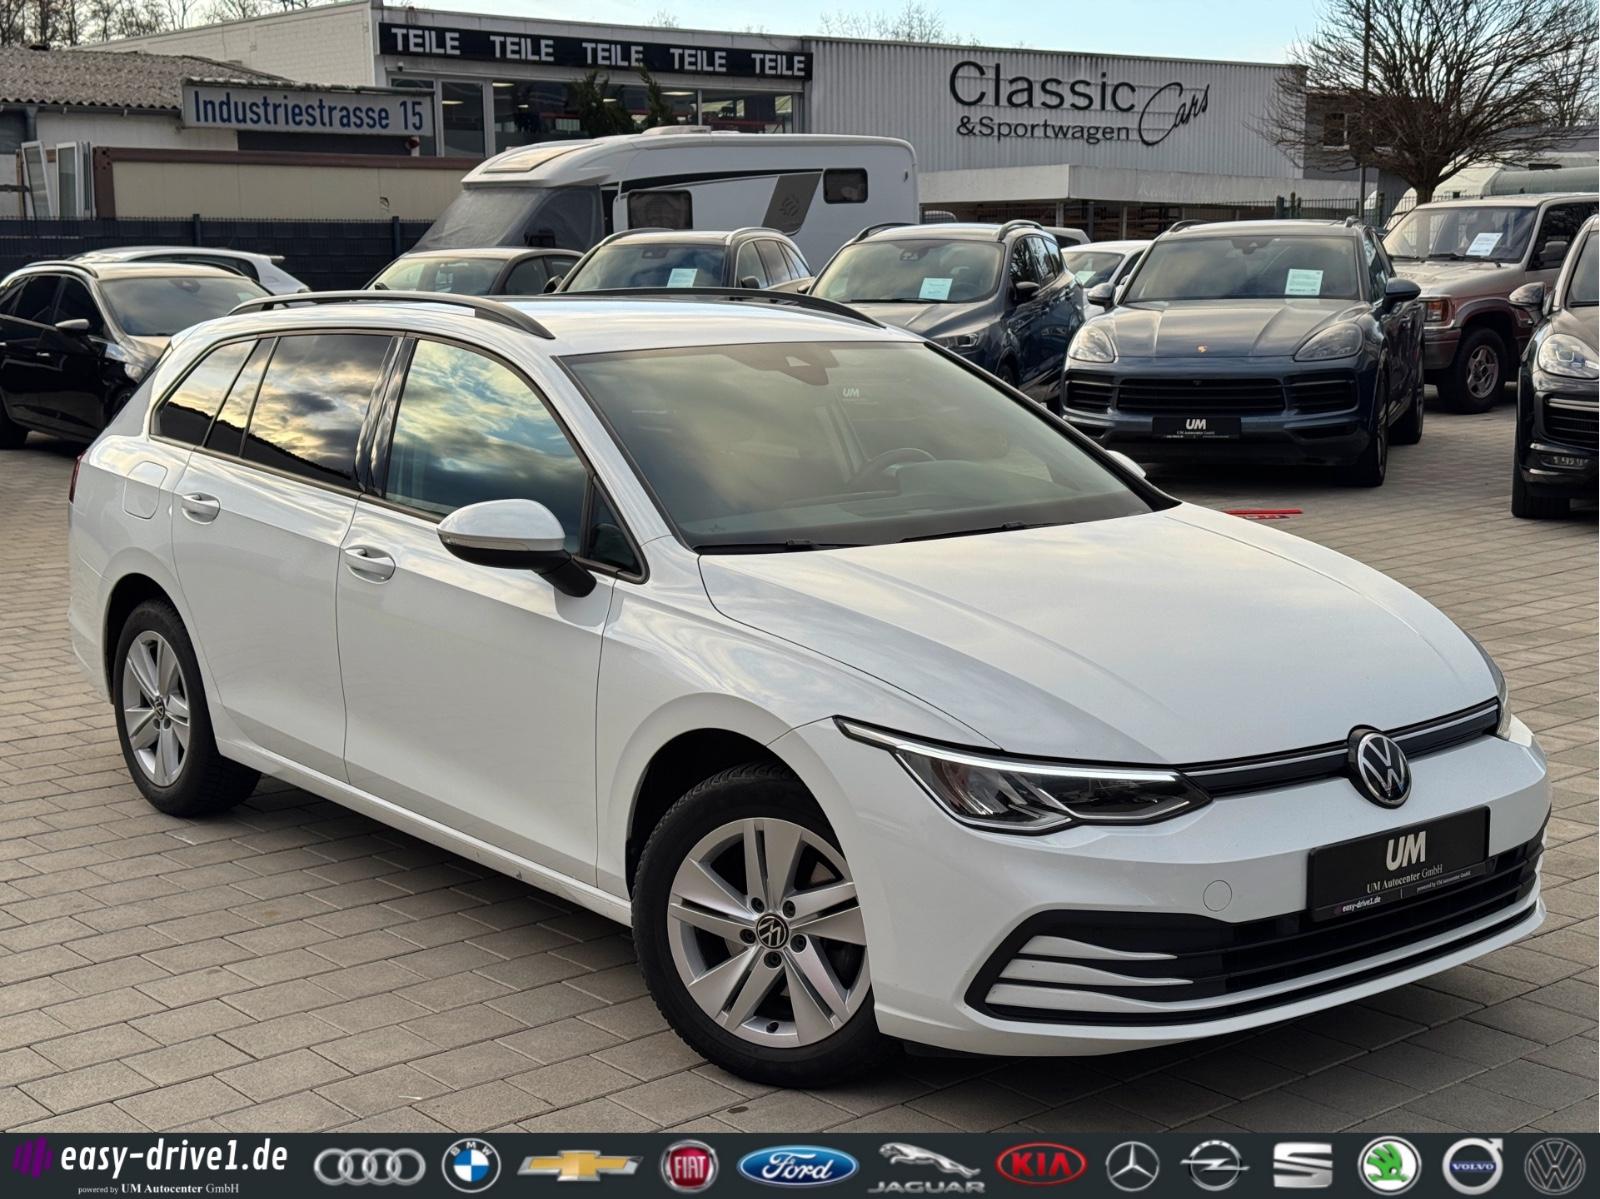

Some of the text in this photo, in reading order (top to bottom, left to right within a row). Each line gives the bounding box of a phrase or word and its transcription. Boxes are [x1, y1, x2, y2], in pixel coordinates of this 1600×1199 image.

[391, 28, 806, 76] TEILE TEILE TEILE TEILE TEILE
[194, 91, 424, 131] Industriestrasse 15
[949, 60, 1211, 146] Classic Cars
[956, 115, 1130, 145] &Sportwagen
[842, 387, 860, 398] UM
[1186, 418, 1207, 430] UM
[1386, 830, 1426, 871] UM
[1367, 880, 1381, 894] UM
[1381, 872, 1421, 889] Autocenter
[1421, 863, 1443, 878] GmbH
